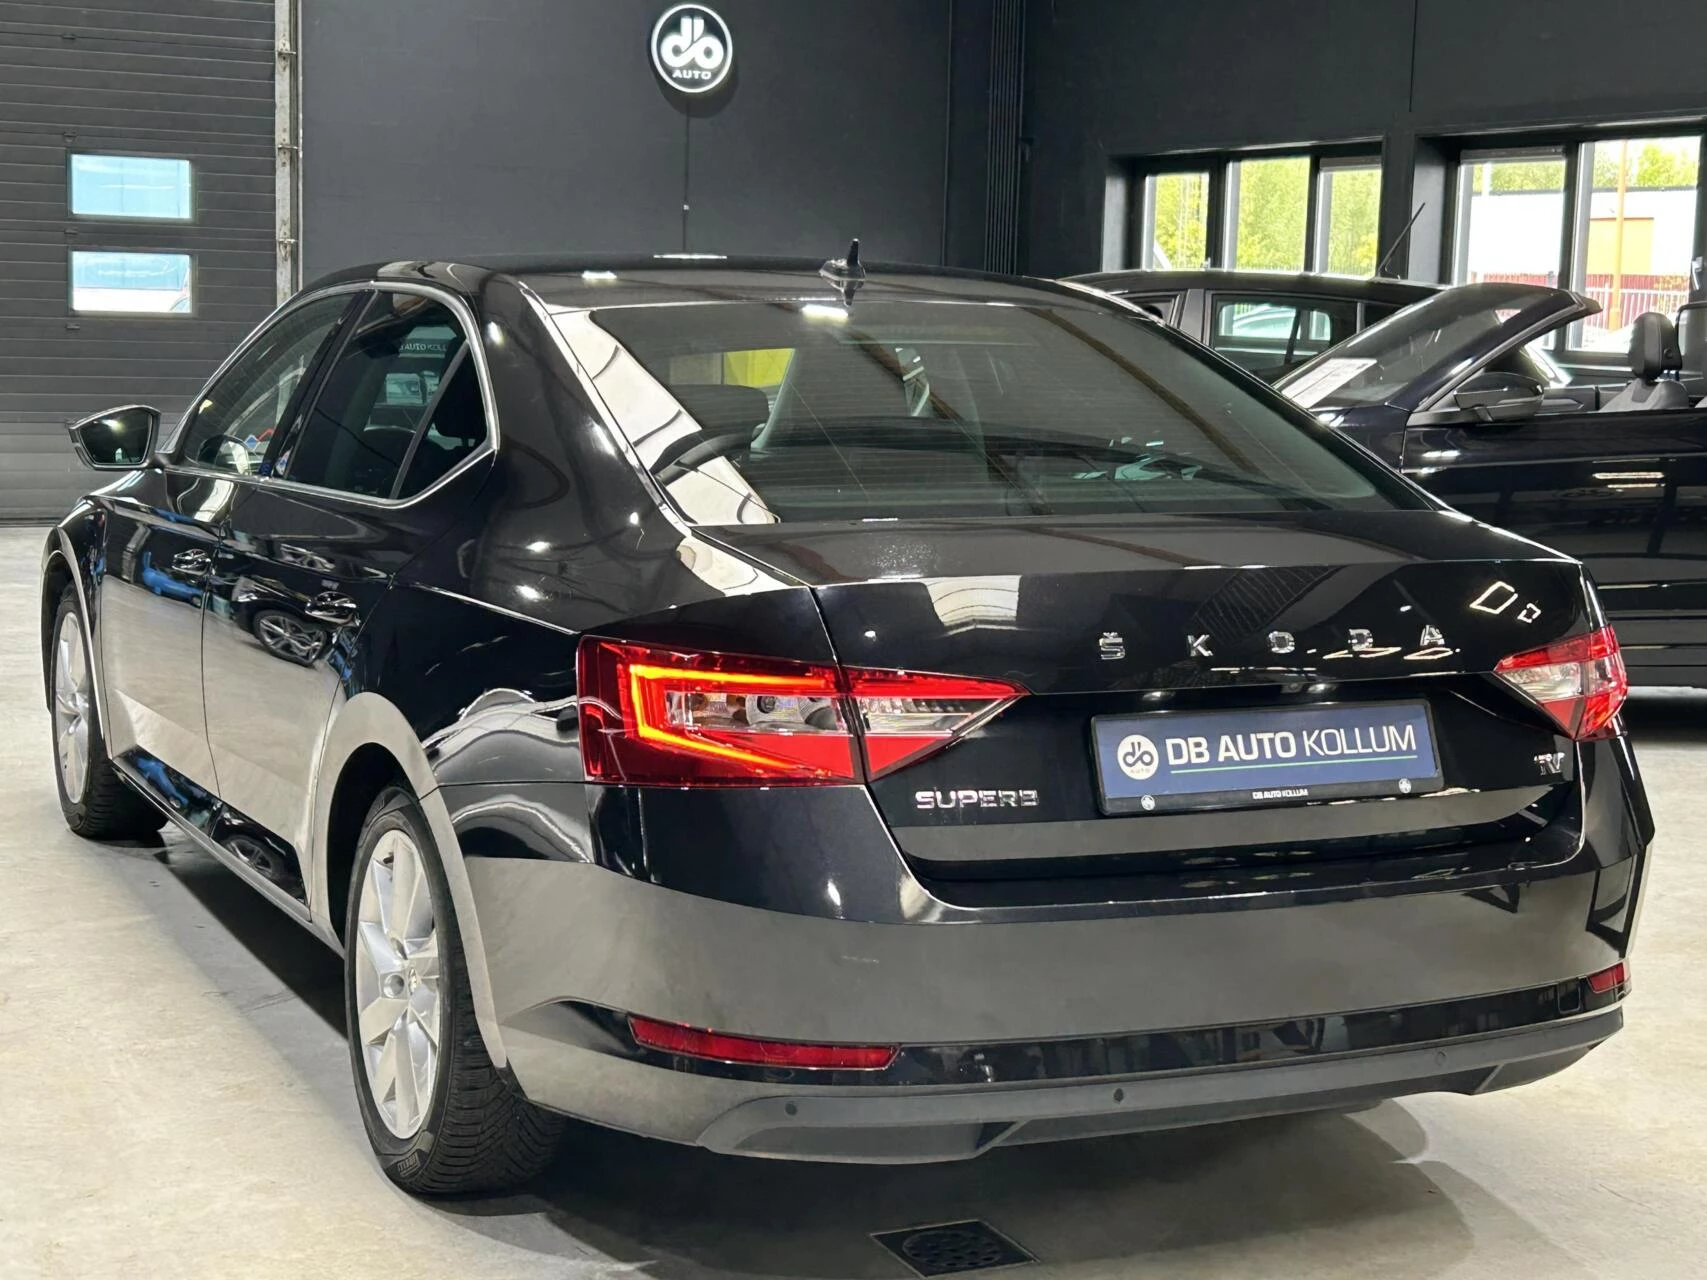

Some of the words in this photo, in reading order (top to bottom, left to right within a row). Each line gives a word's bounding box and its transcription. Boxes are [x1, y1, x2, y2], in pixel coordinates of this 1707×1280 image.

[672, 69, 712, 80] AUTO
[1099, 624, 1446, 661] ŠKODA
[1165, 737, 1210, 765] DB
[1217, 731, 1297, 763] AUTO
[1302, 724, 1417, 757] KOLLUM
[914, 789, 1039, 809] SUPERB
[1264, 790, 1282, 799] AUTO
